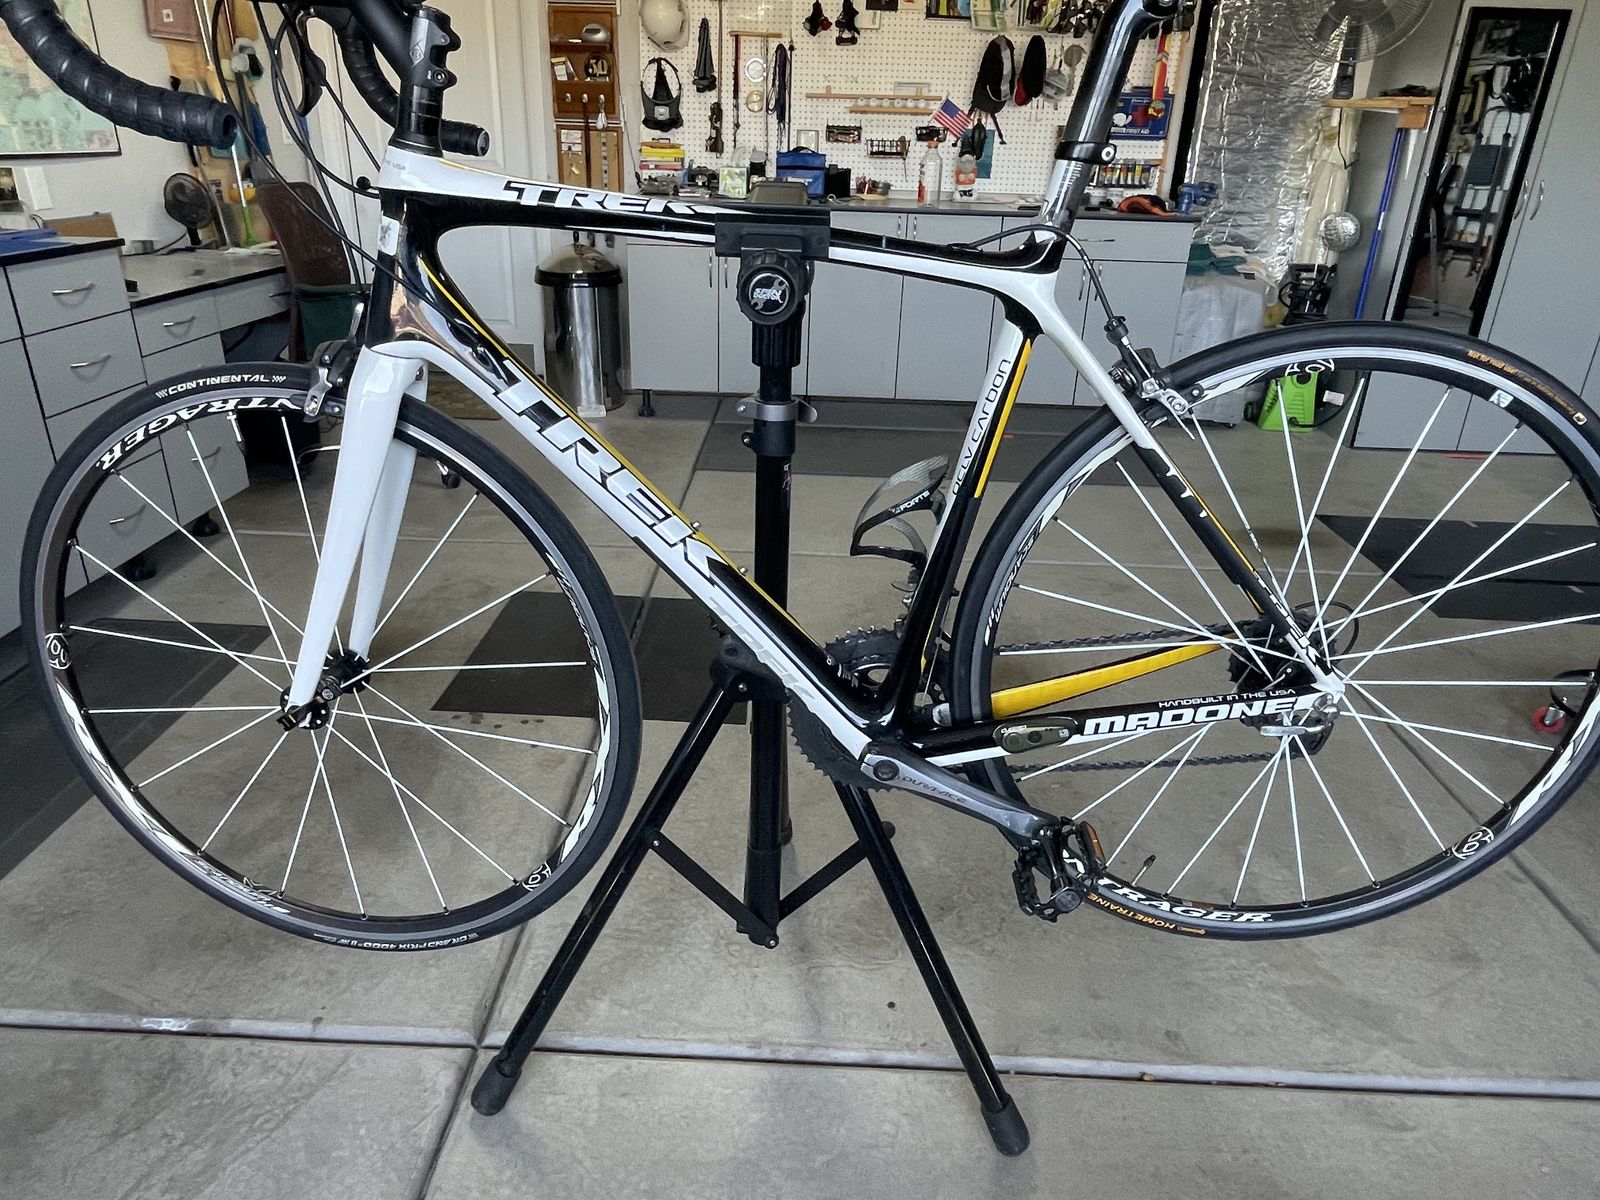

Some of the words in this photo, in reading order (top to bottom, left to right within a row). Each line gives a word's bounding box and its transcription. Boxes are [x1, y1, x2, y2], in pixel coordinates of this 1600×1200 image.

[503, 181, 699, 215] TREK
[168, 374, 270, 395] CONTINENTAL
[496, 358, 728, 579] TREK
[1083, 696, 1296, 736] MADONE
[1158, 695, 1224, 708] HANDBUILT
[1242, 690, 1267, 699] THE
[1269, 688, 1297, 697] USA
[1086, 892, 1176, 930] HOMETRAINE
